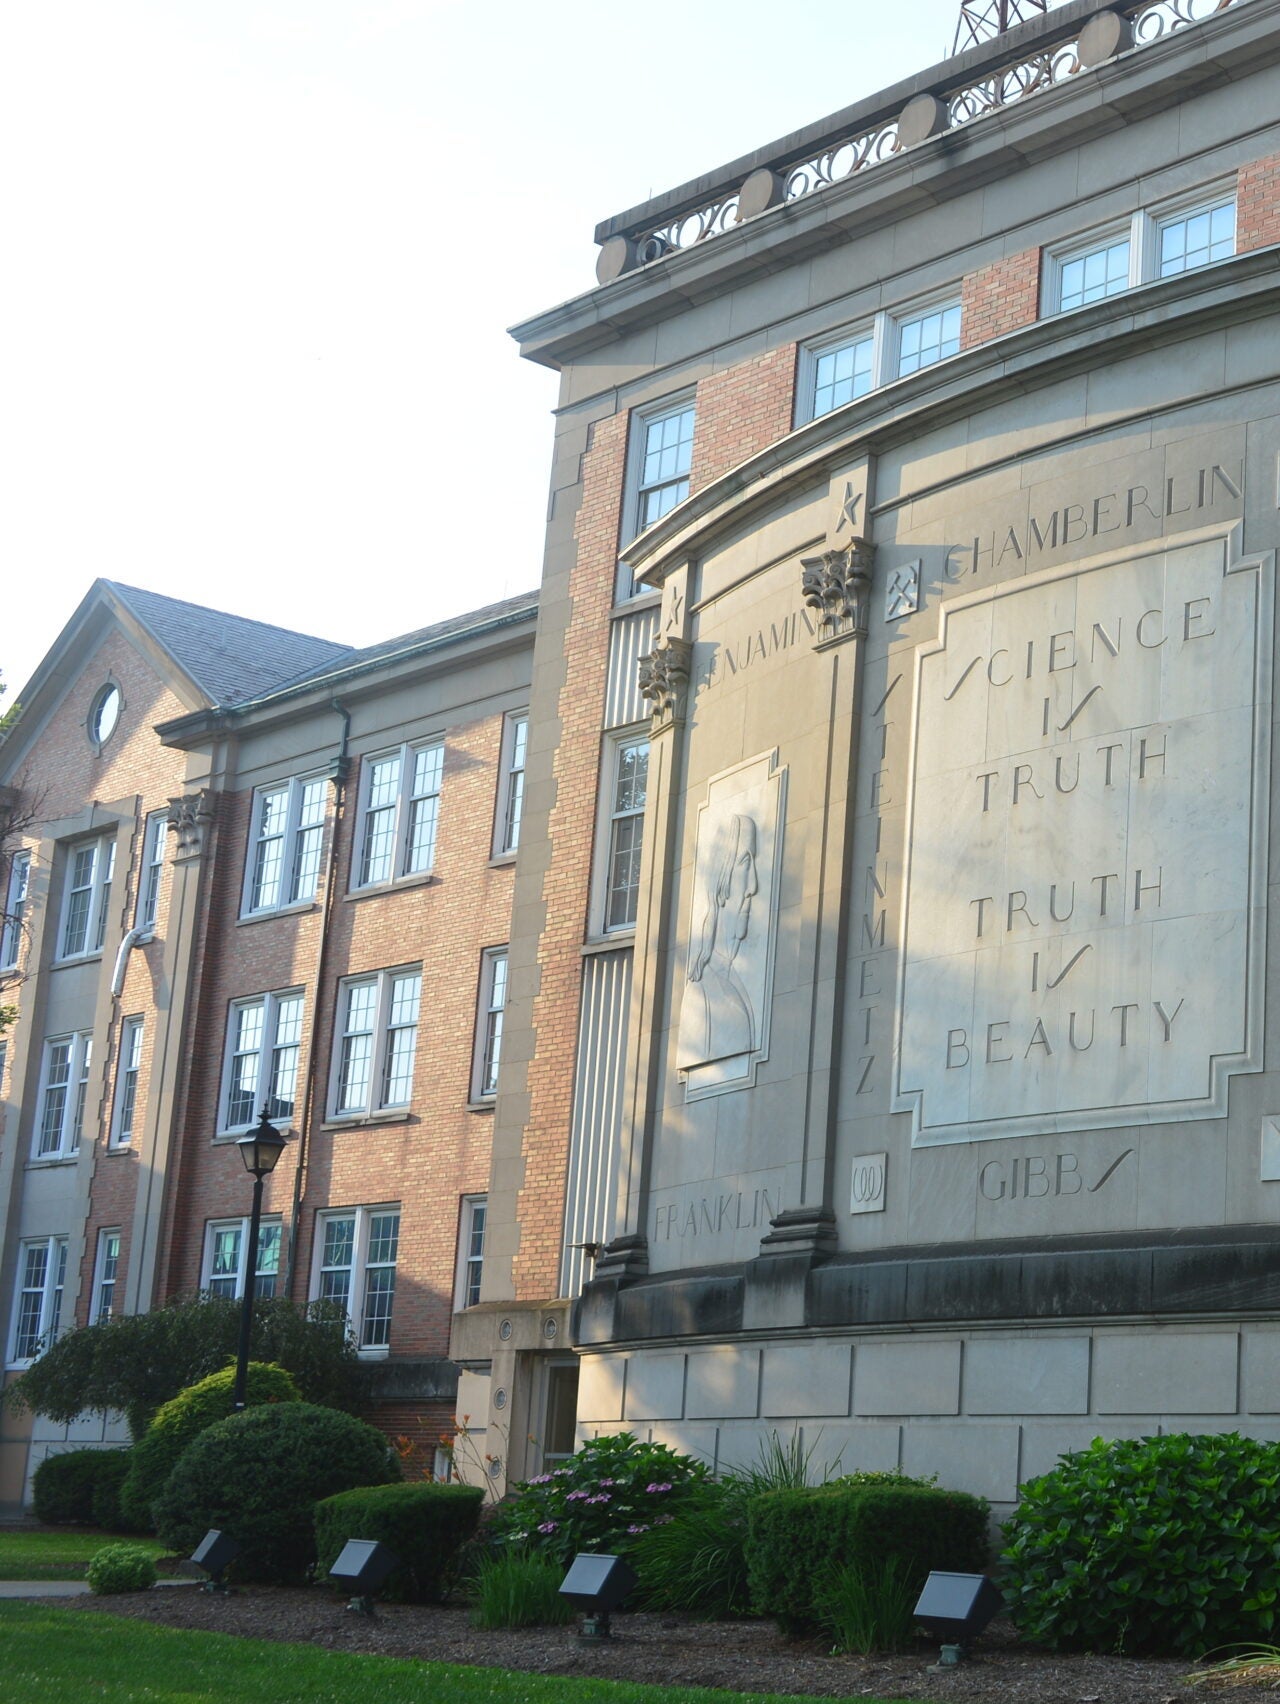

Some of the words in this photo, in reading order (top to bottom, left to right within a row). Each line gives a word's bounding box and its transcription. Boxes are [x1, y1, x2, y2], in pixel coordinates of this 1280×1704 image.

[944, 459, 1244, 580] CHAMBERLIN
[943, 597, 1217, 701] SCIENCE
[1042, 685, 1104, 736] IS
[975, 734, 1168, 813] TRUTH
[855, 673, 904, 1096] STEINMETZ
[969, 866, 1162, 937] TRUTH
[1031, 944, 1094, 992] IS
[945, 998, 1185, 1070] BEAUTY
[978, 1148, 1135, 1201] GIBBS
[654, 1187, 782, 1242] FRANKLIN
